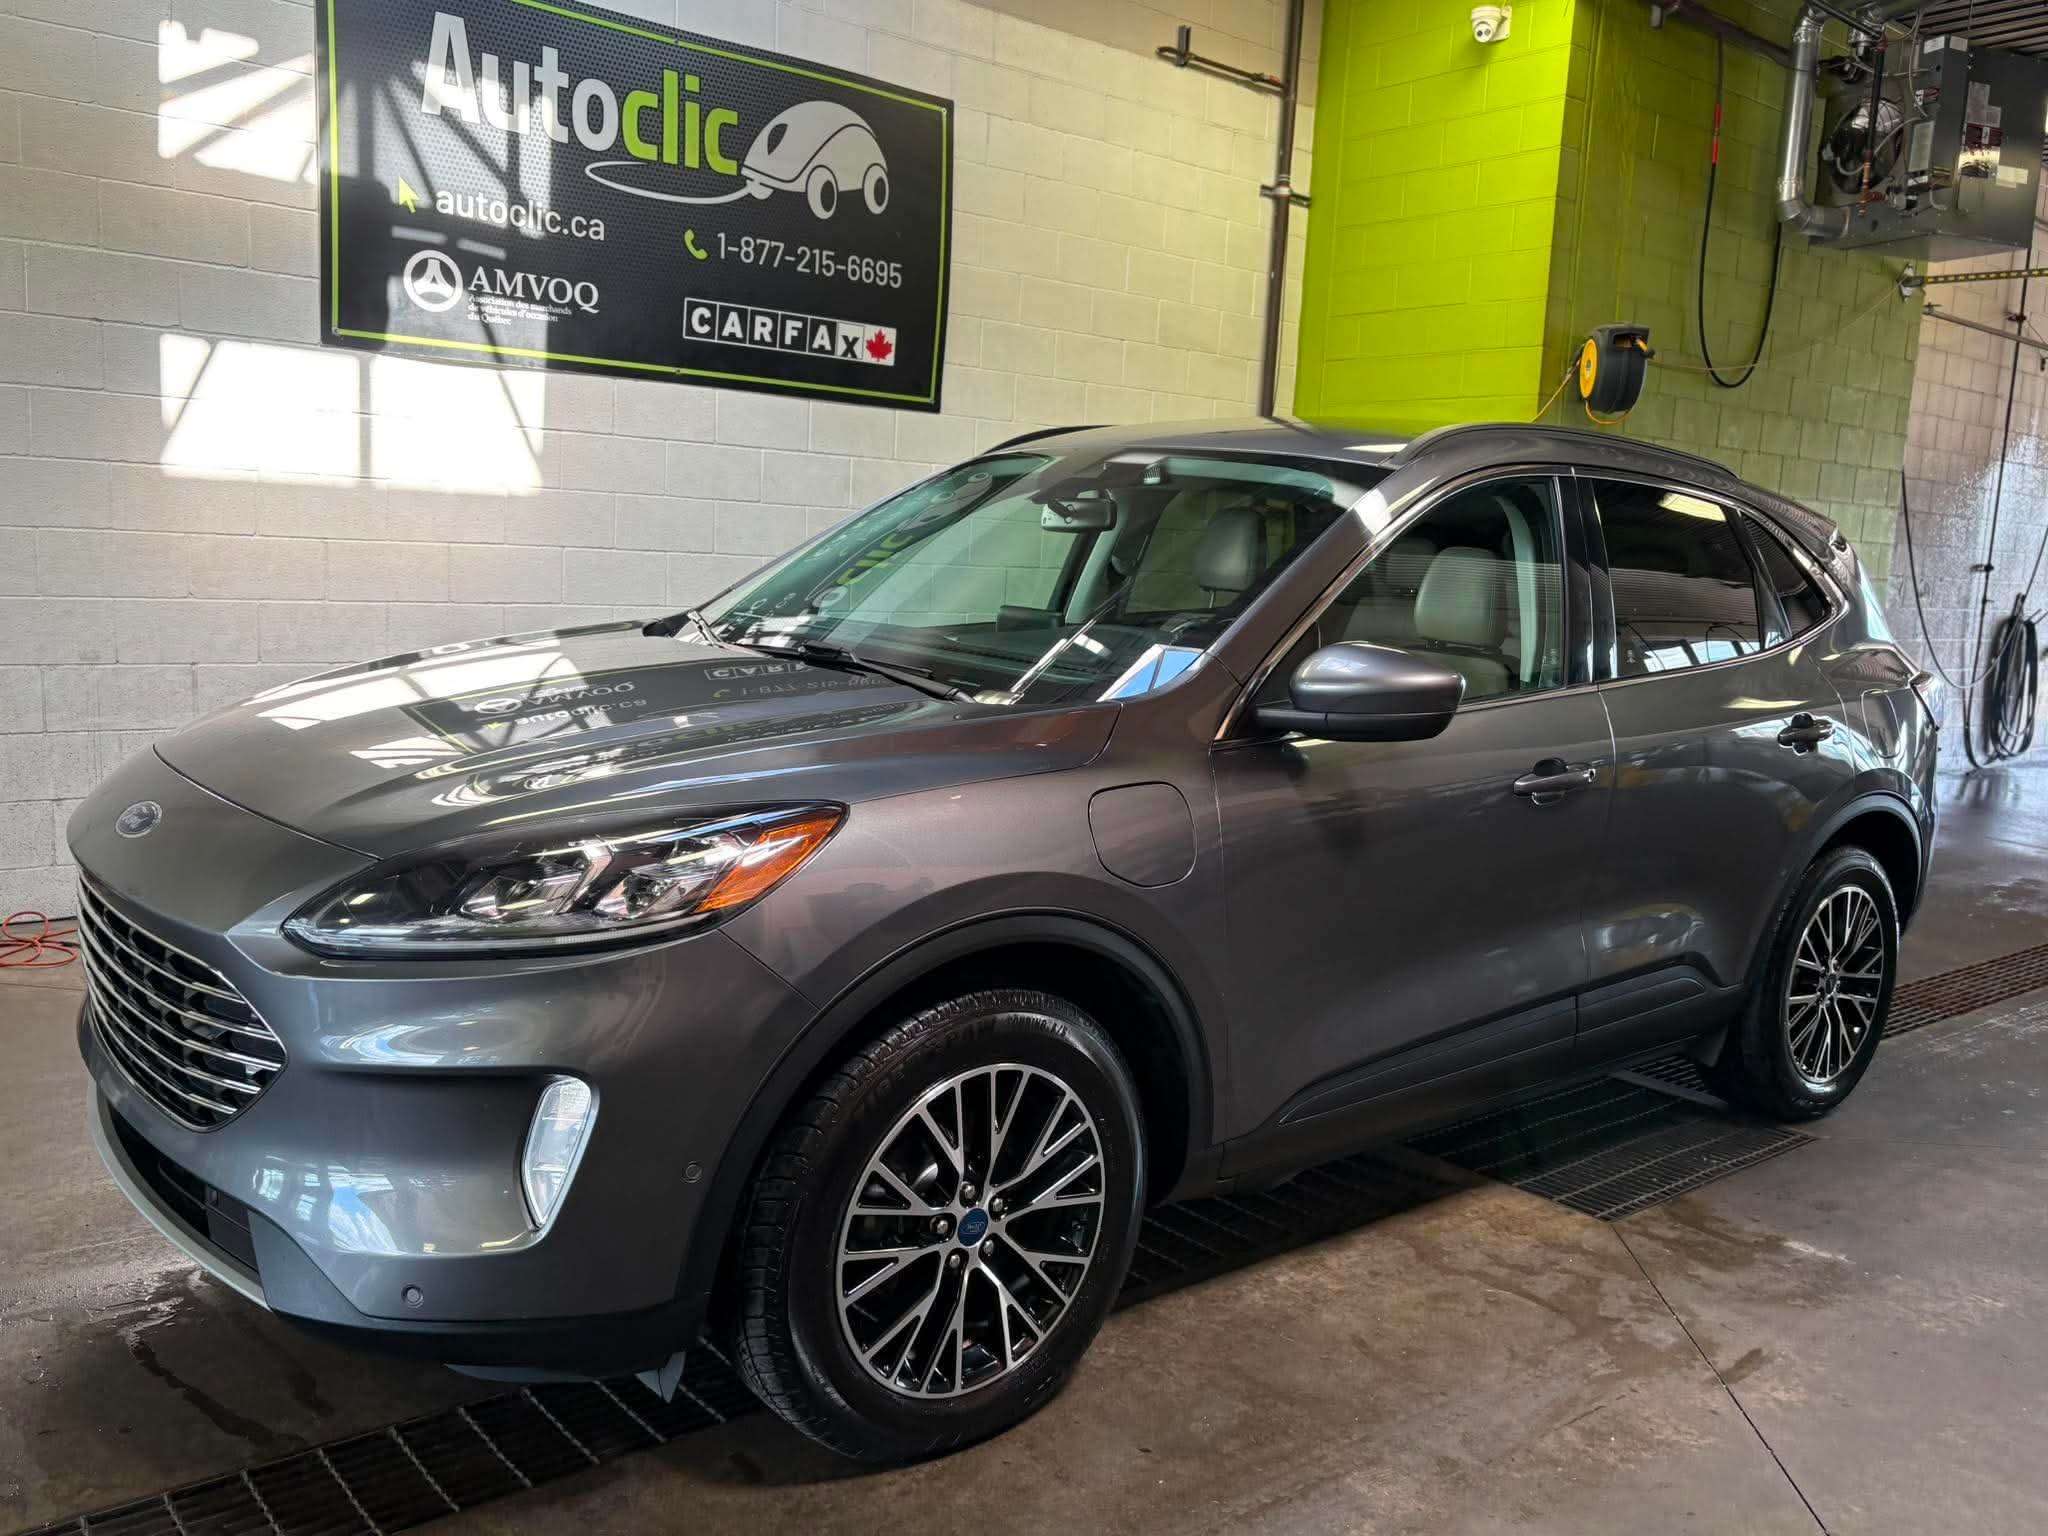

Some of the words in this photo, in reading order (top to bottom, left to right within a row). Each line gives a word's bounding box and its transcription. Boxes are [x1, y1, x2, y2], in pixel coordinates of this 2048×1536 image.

[420, 11, 742, 176] Autoclic
[436, 190, 606, 241] autoclic.ca
[717, 232, 903, 289] 1-877-215-6695
[467, 265, 600, 314] AMVOQ
[690, 306, 860, 359] CARFAX
